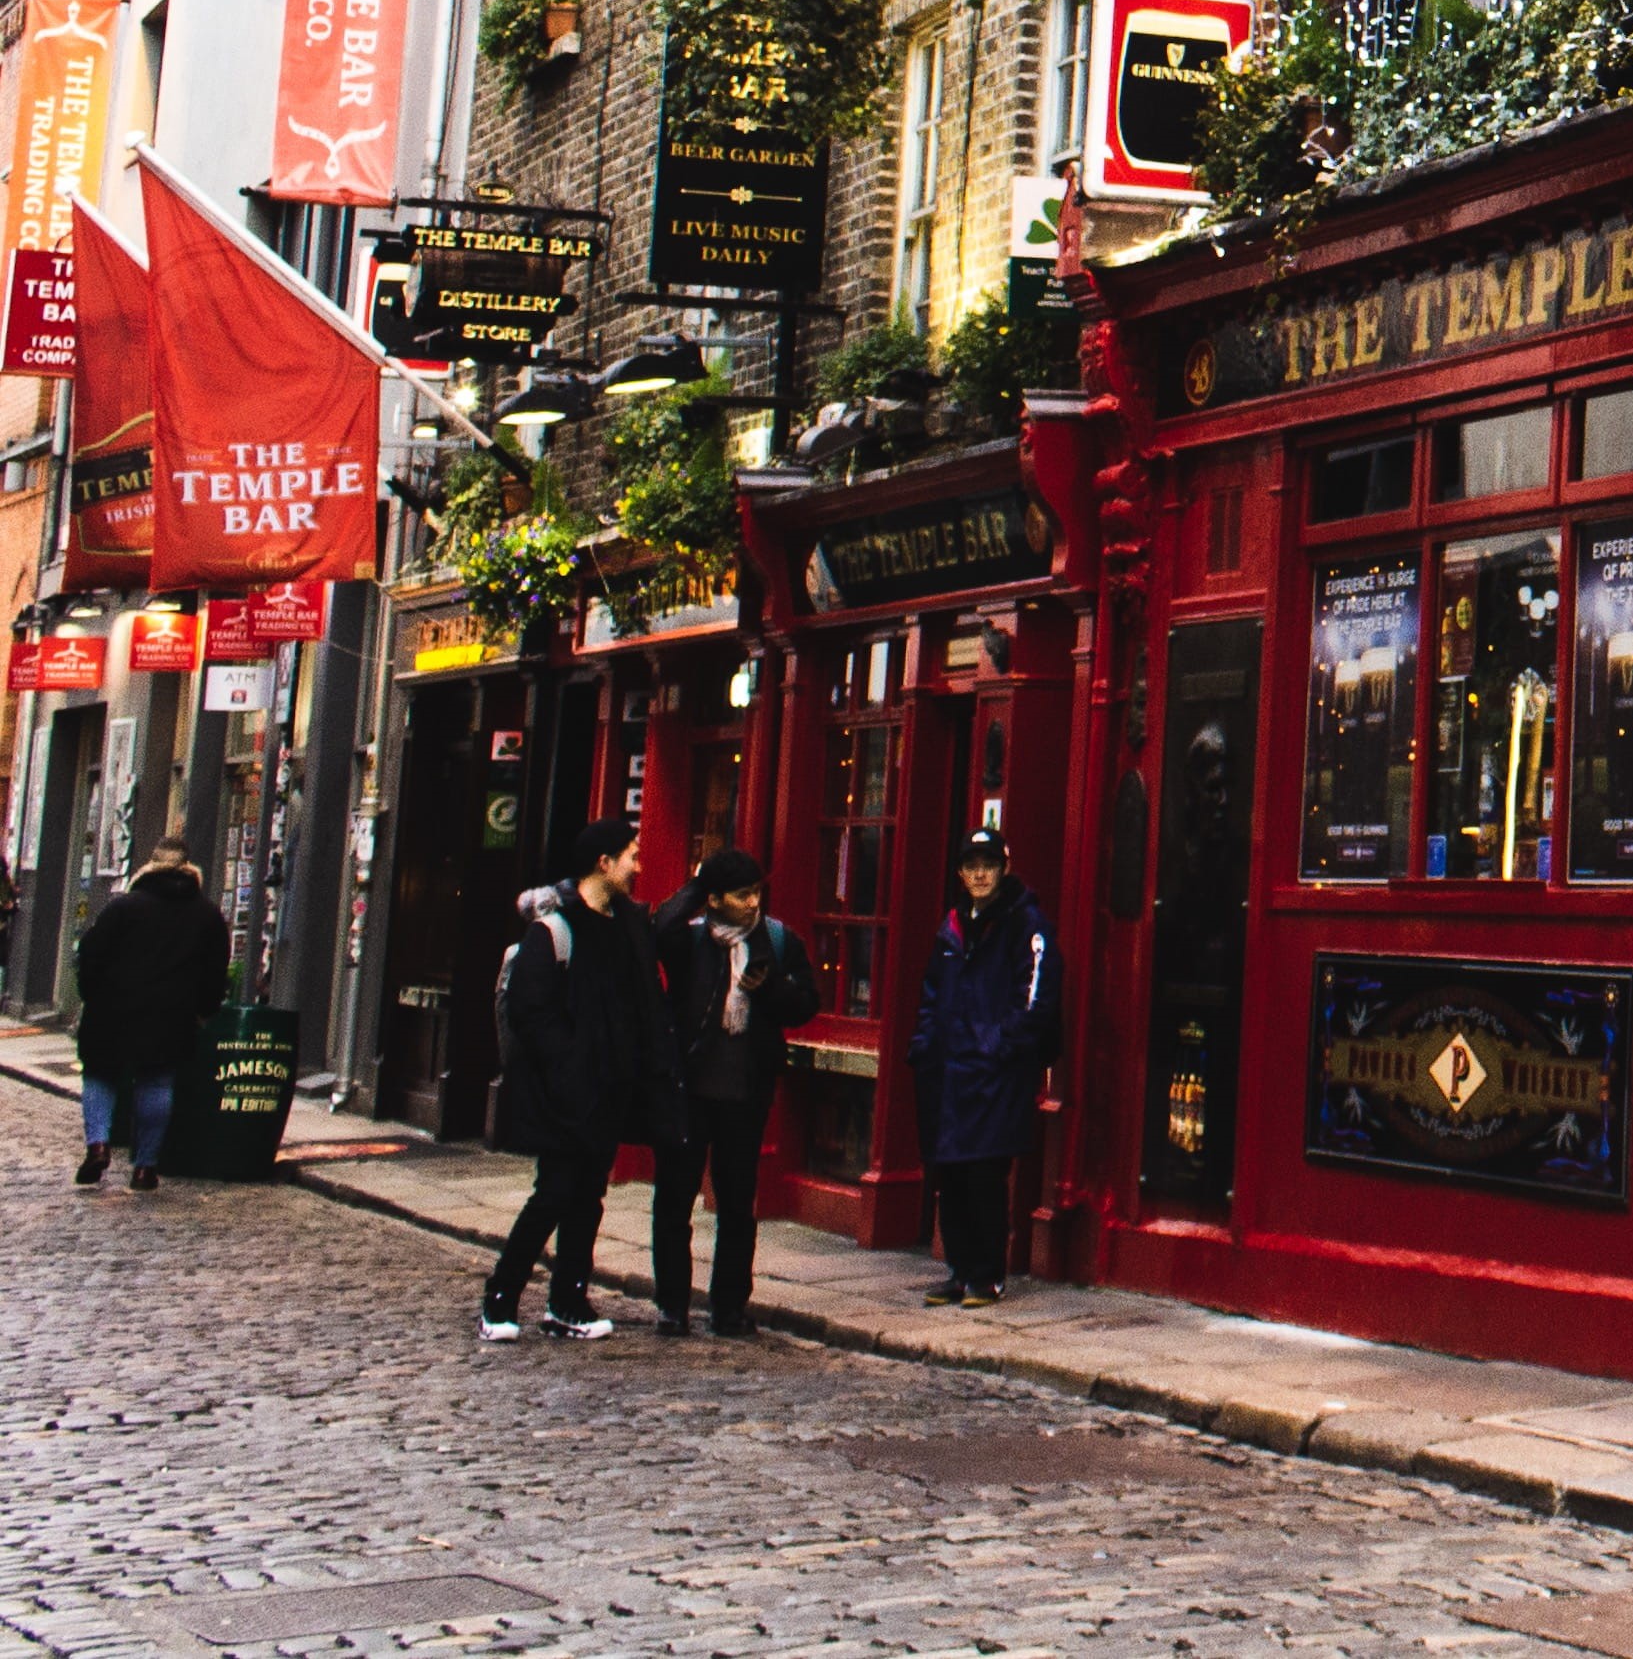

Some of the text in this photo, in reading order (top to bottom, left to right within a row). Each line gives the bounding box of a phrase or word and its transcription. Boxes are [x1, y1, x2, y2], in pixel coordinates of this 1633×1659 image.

[339, 28, 378, 108] BAR
[1131, 63, 1217, 86] GUINNESS
[62, 56, 94, 115] THE
[23, 96, 54, 213] TRADING
[671, 142, 816, 168] BEER GARDEN
[48, 123, 87, 234] TEMLE
[414, 228, 591, 256] THE TEMPLE BAR
[671, 220, 807, 245] LIVE MUSIC
[701, 245, 773, 265] DAILY
[25, 279, 74, 299] TEM
[43, 304, 76, 322] BA
[438, 290, 561, 314] DISTILLERY
[31, 335, 75, 349] TRAD
[462, 323, 532, 342] STORE
[1277, 293, 1383, 384] THE
[22, 351, 75, 364] COMP
[227, 443, 305, 468] THE
[172, 463, 364, 504] TEMPLE
[223, 502, 320, 535] BAR
[1602, 564, 1619, 581] OF
[225, 673, 256, 682] ATM
[215, 1060, 288, 1081] JAMESON
